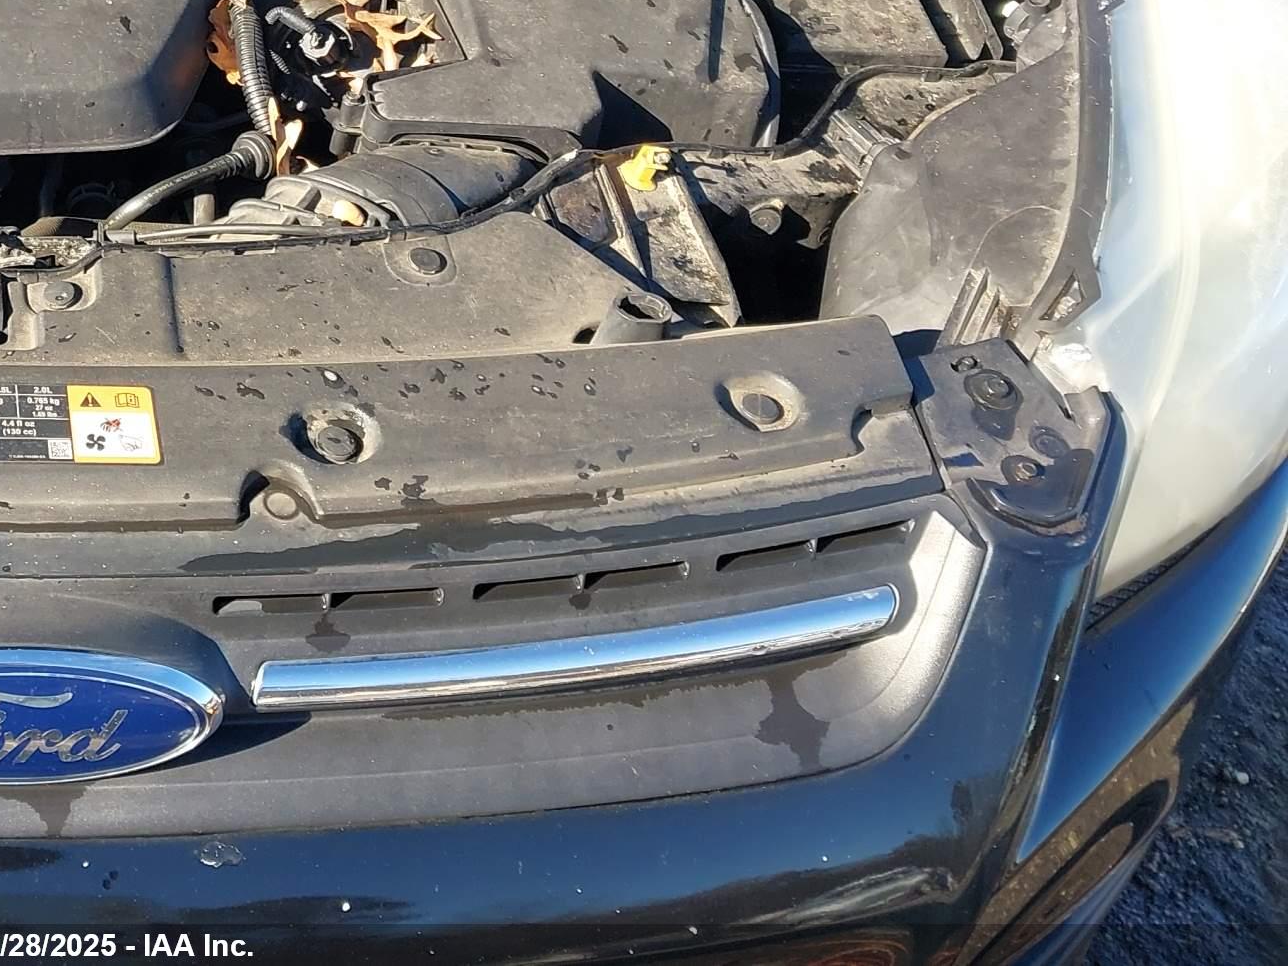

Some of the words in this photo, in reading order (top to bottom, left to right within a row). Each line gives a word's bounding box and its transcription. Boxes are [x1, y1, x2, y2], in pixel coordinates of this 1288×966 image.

[33, 386, 53, 394] 2.0L
[2, 428, 22, 436] (130
[23, 428, 37, 436] cc)
